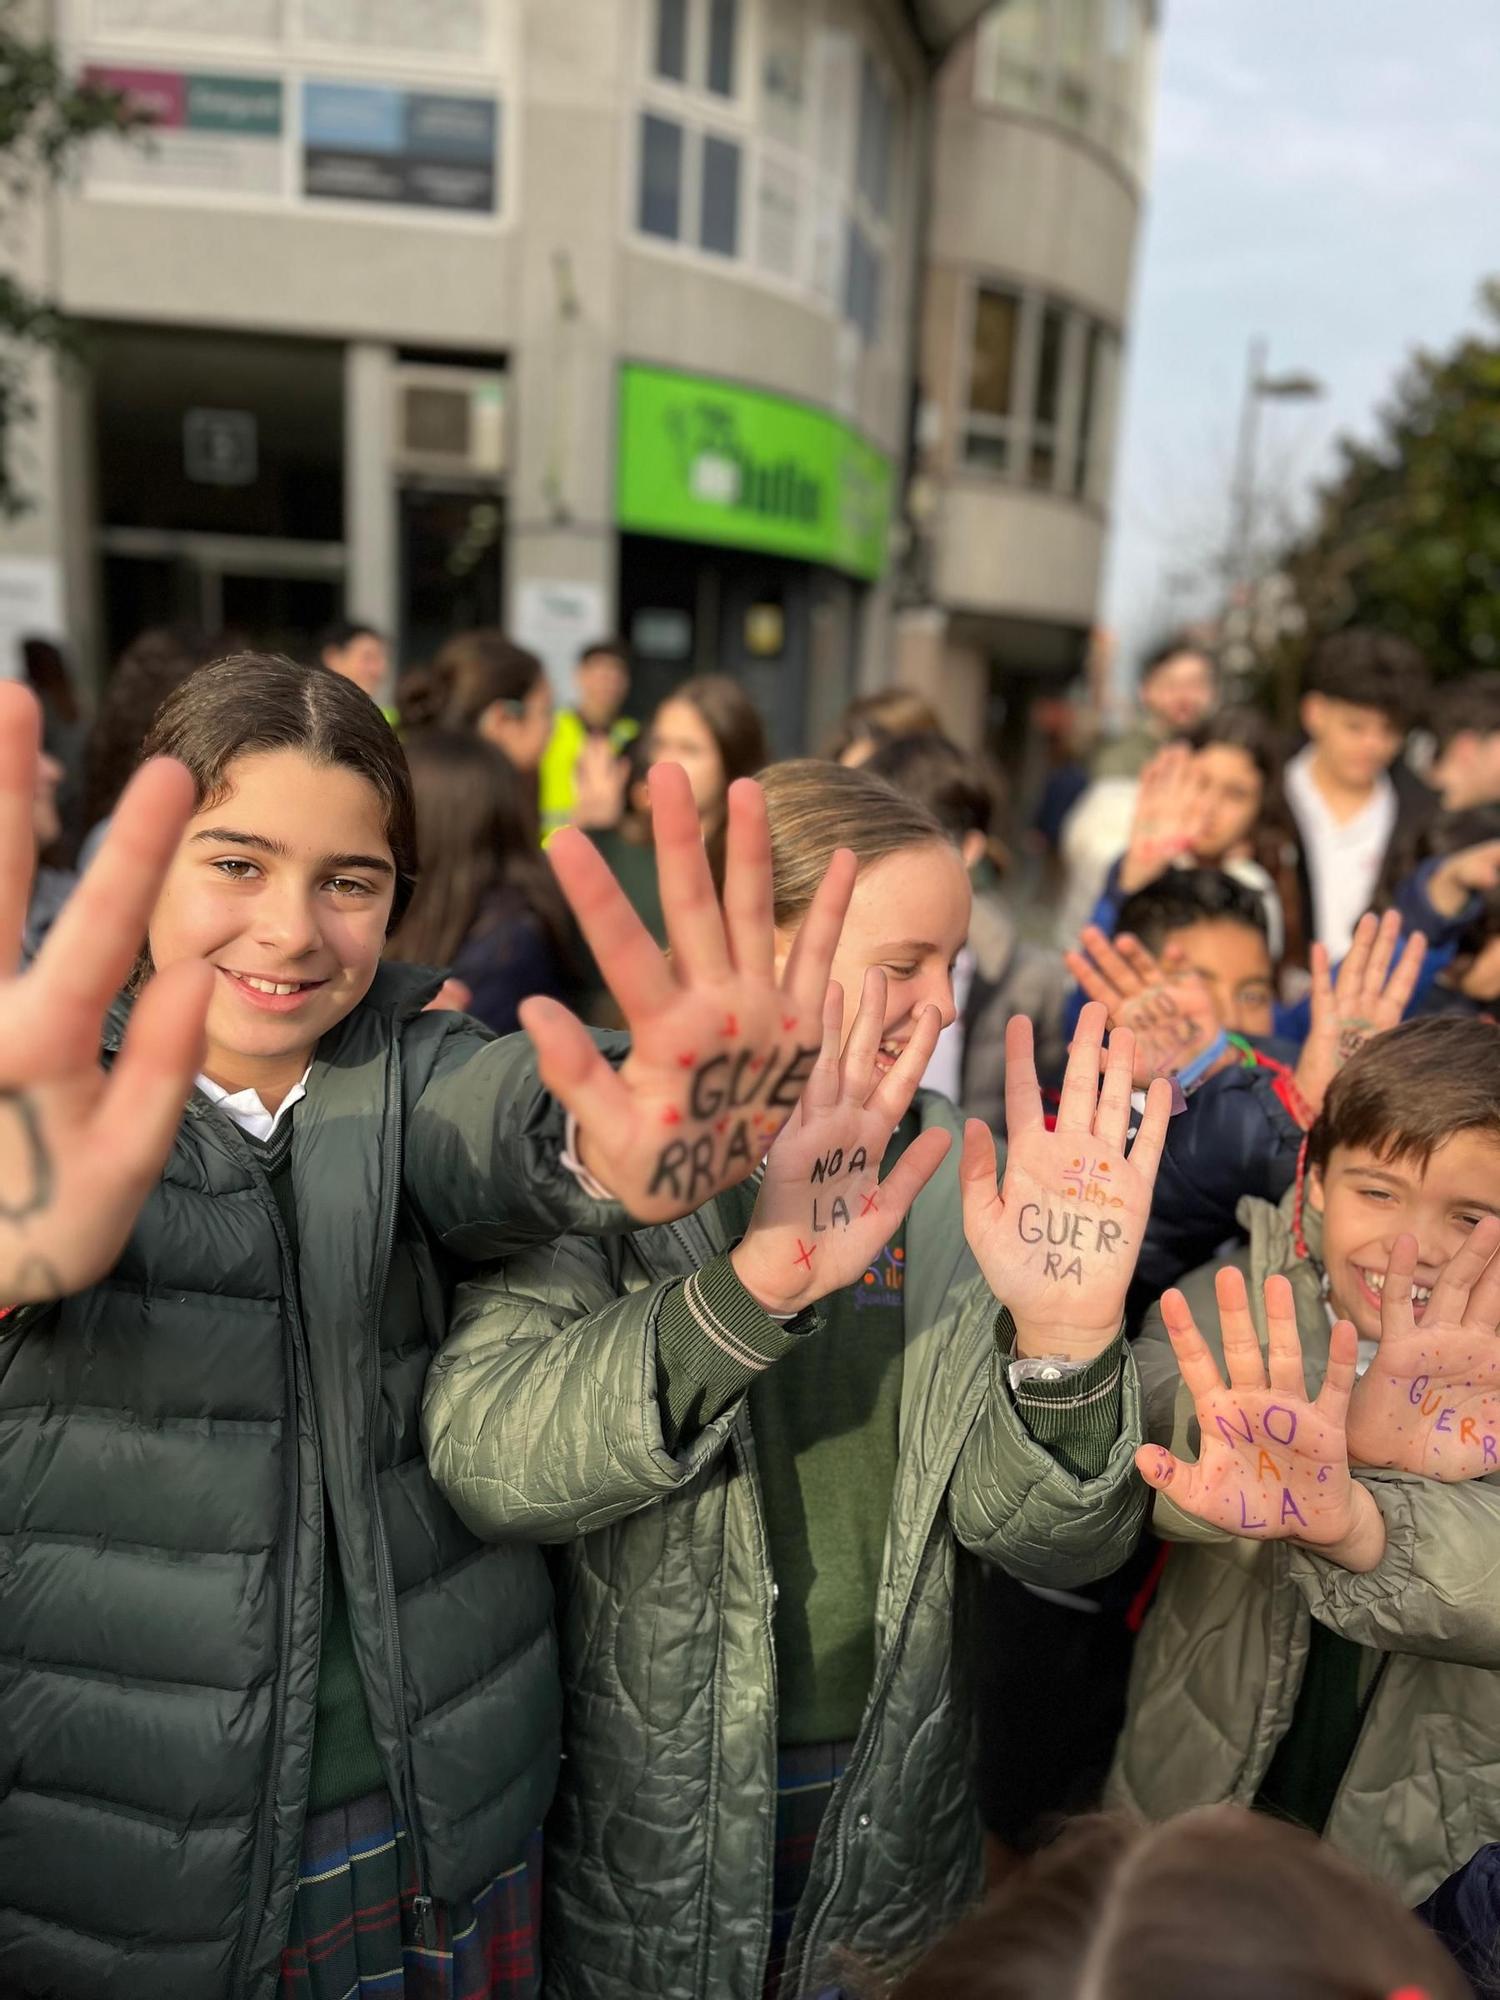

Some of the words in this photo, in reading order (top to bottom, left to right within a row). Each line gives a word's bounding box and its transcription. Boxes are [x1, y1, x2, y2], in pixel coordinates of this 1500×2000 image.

[688, 1043, 822, 1121] GUE
[647, 1119, 755, 1204] RRA
[811, 1195, 850, 1232] LA
[1042, 1251, 1083, 1286] RA
[1215, 1405, 1298, 1449] NO
[1257, 1449, 1281, 1482] A
[1240, 1488, 1308, 1528] LA
